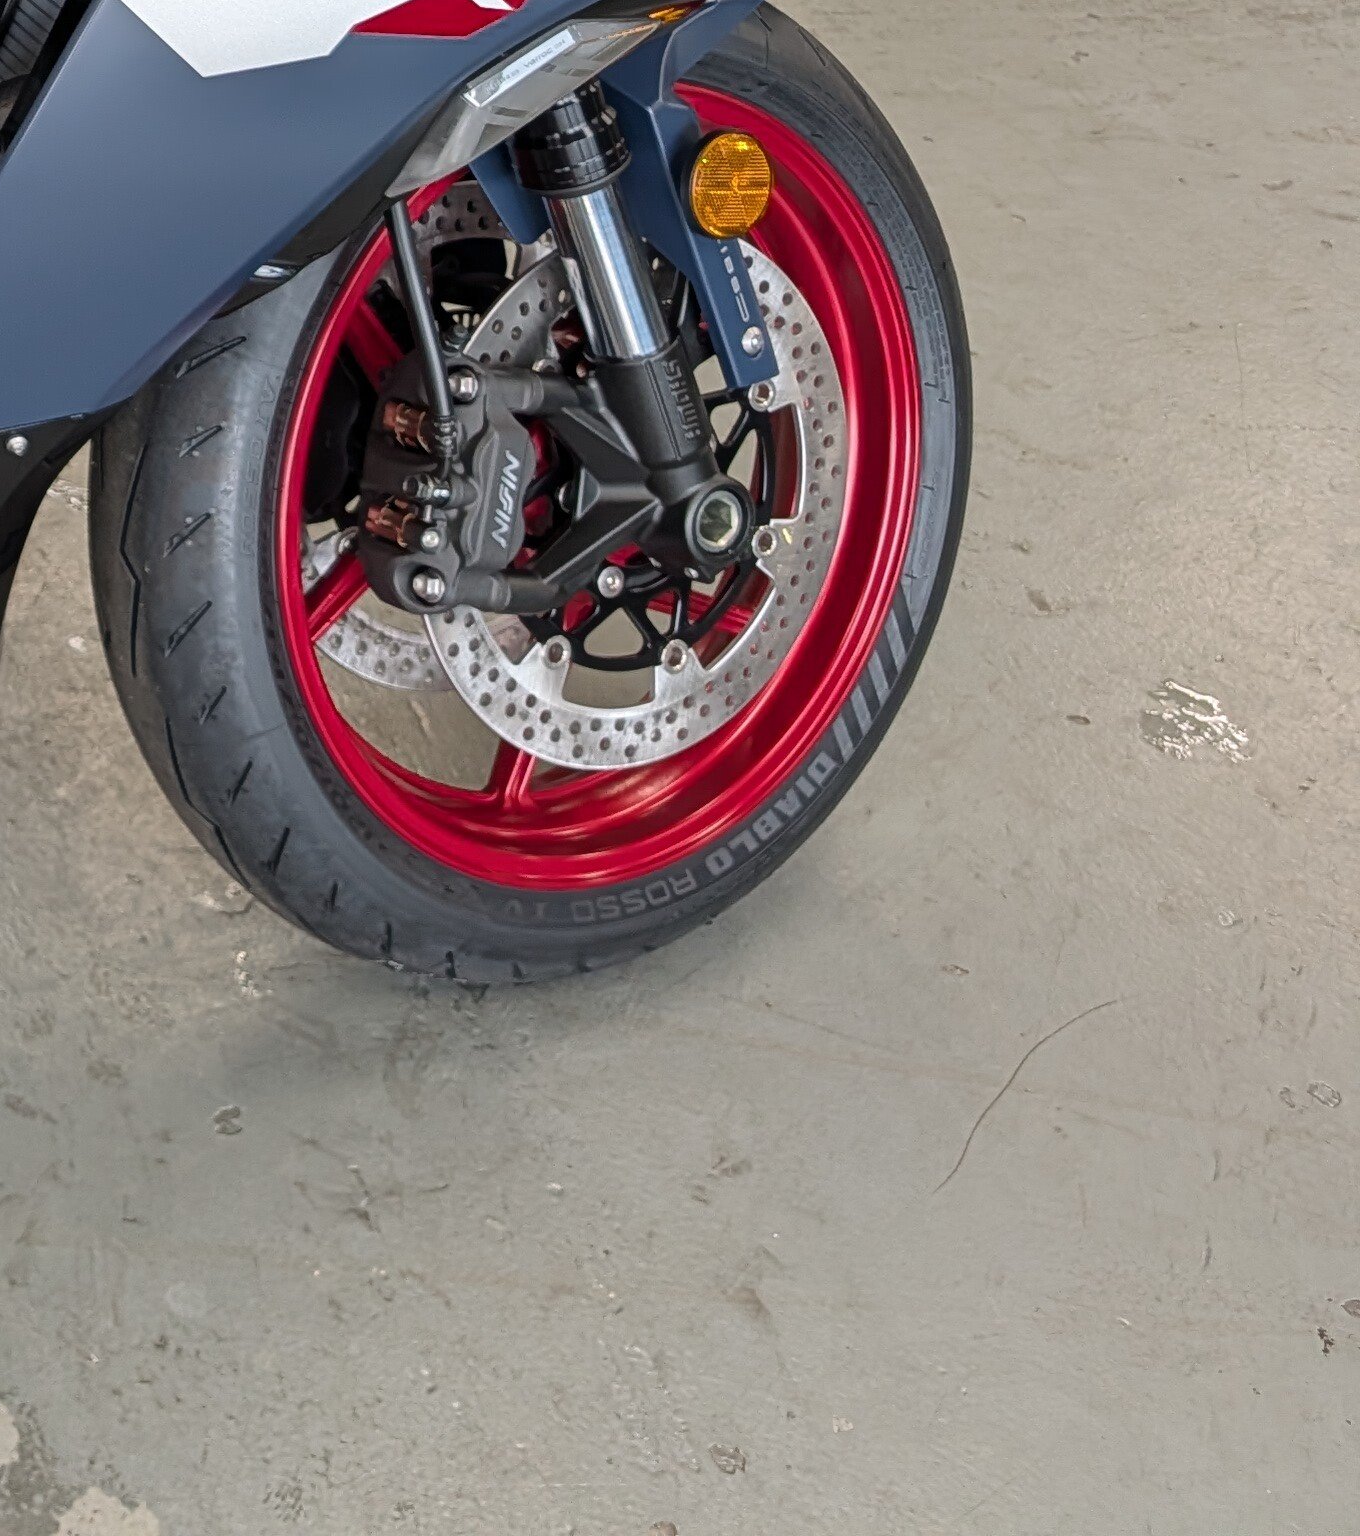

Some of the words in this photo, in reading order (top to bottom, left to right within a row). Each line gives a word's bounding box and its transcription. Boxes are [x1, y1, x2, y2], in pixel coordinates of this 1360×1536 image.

[491, 449, 520, 548] NISSIN
[704, 759, 840, 878] DIABLO
[572, 867, 698, 924] ROSSO
